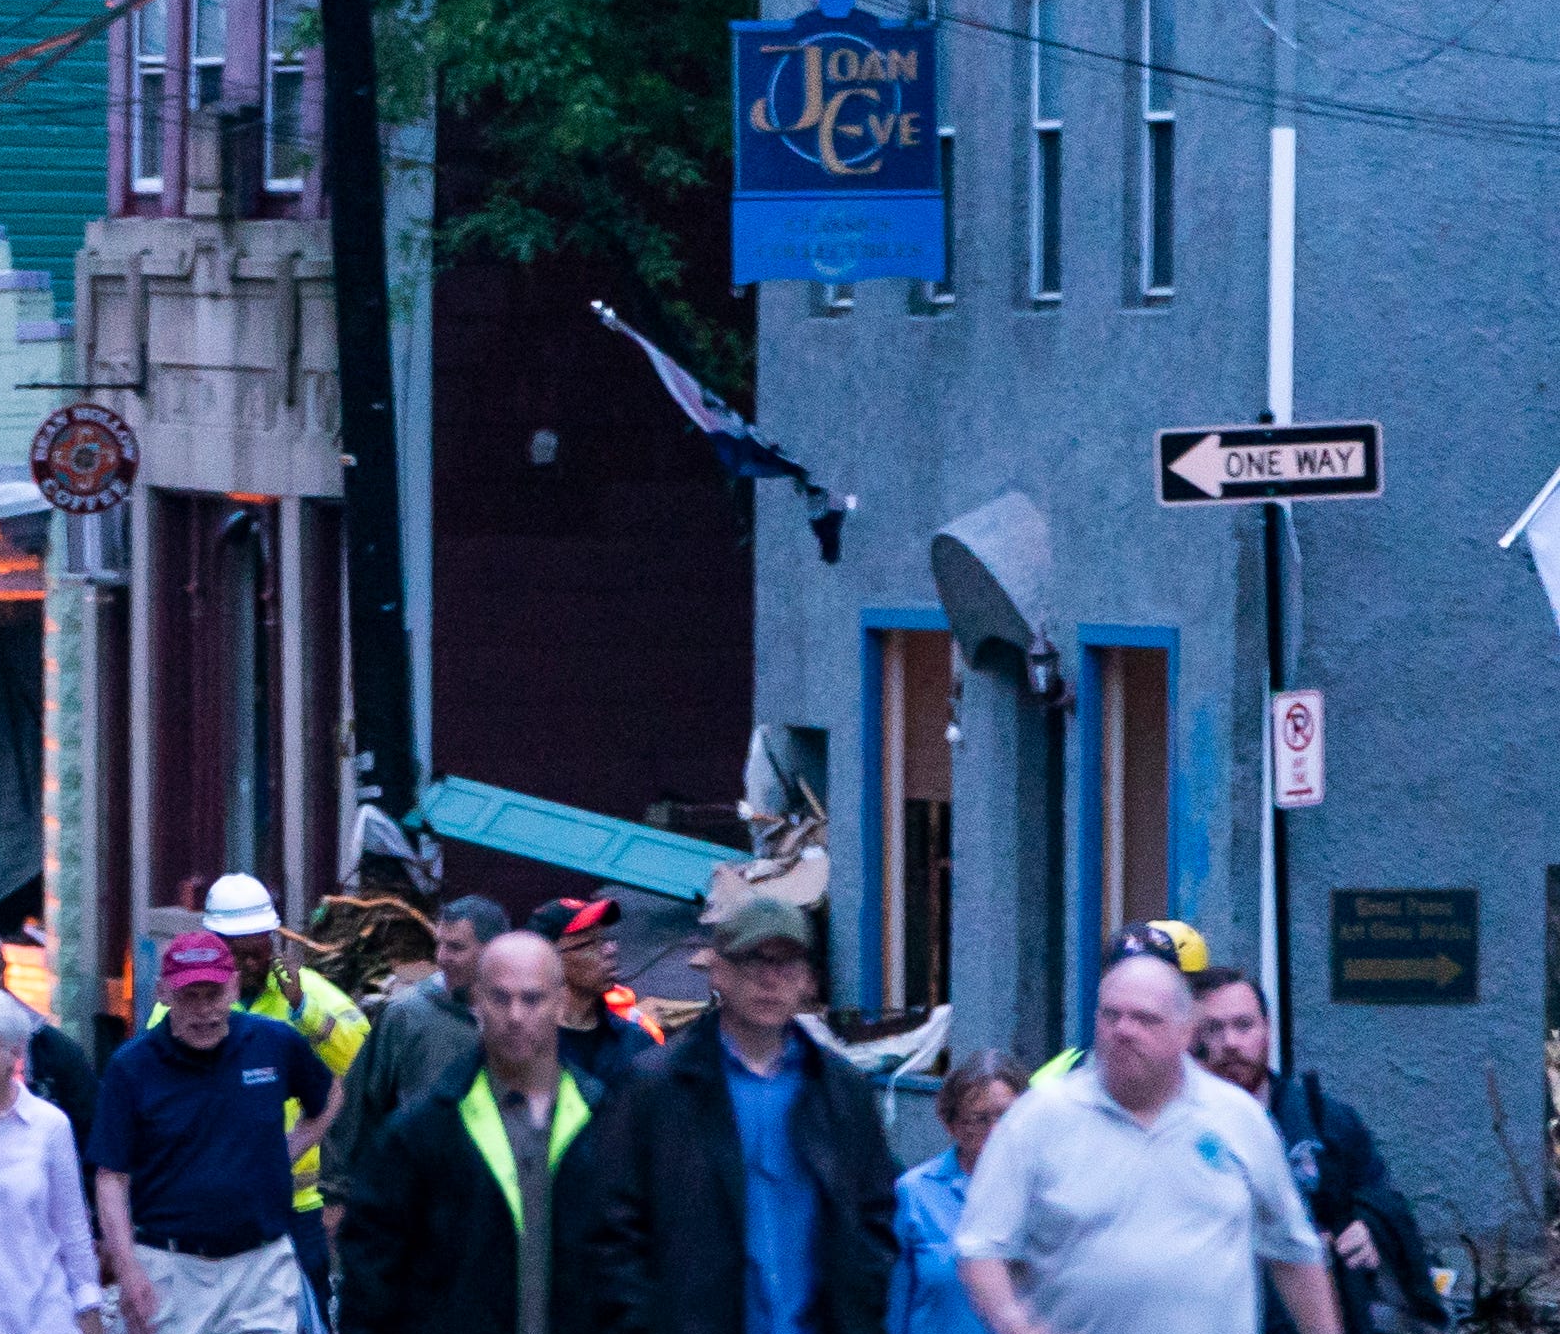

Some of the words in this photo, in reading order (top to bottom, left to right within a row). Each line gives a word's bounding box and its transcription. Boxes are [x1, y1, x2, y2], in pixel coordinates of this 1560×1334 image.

[749, 43, 919, 133] JOAN
[1225, 450, 1281, 478] ONE
[1295, 446, 1355, 477] WAY
[41, 478, 127, 510] COFFEE
